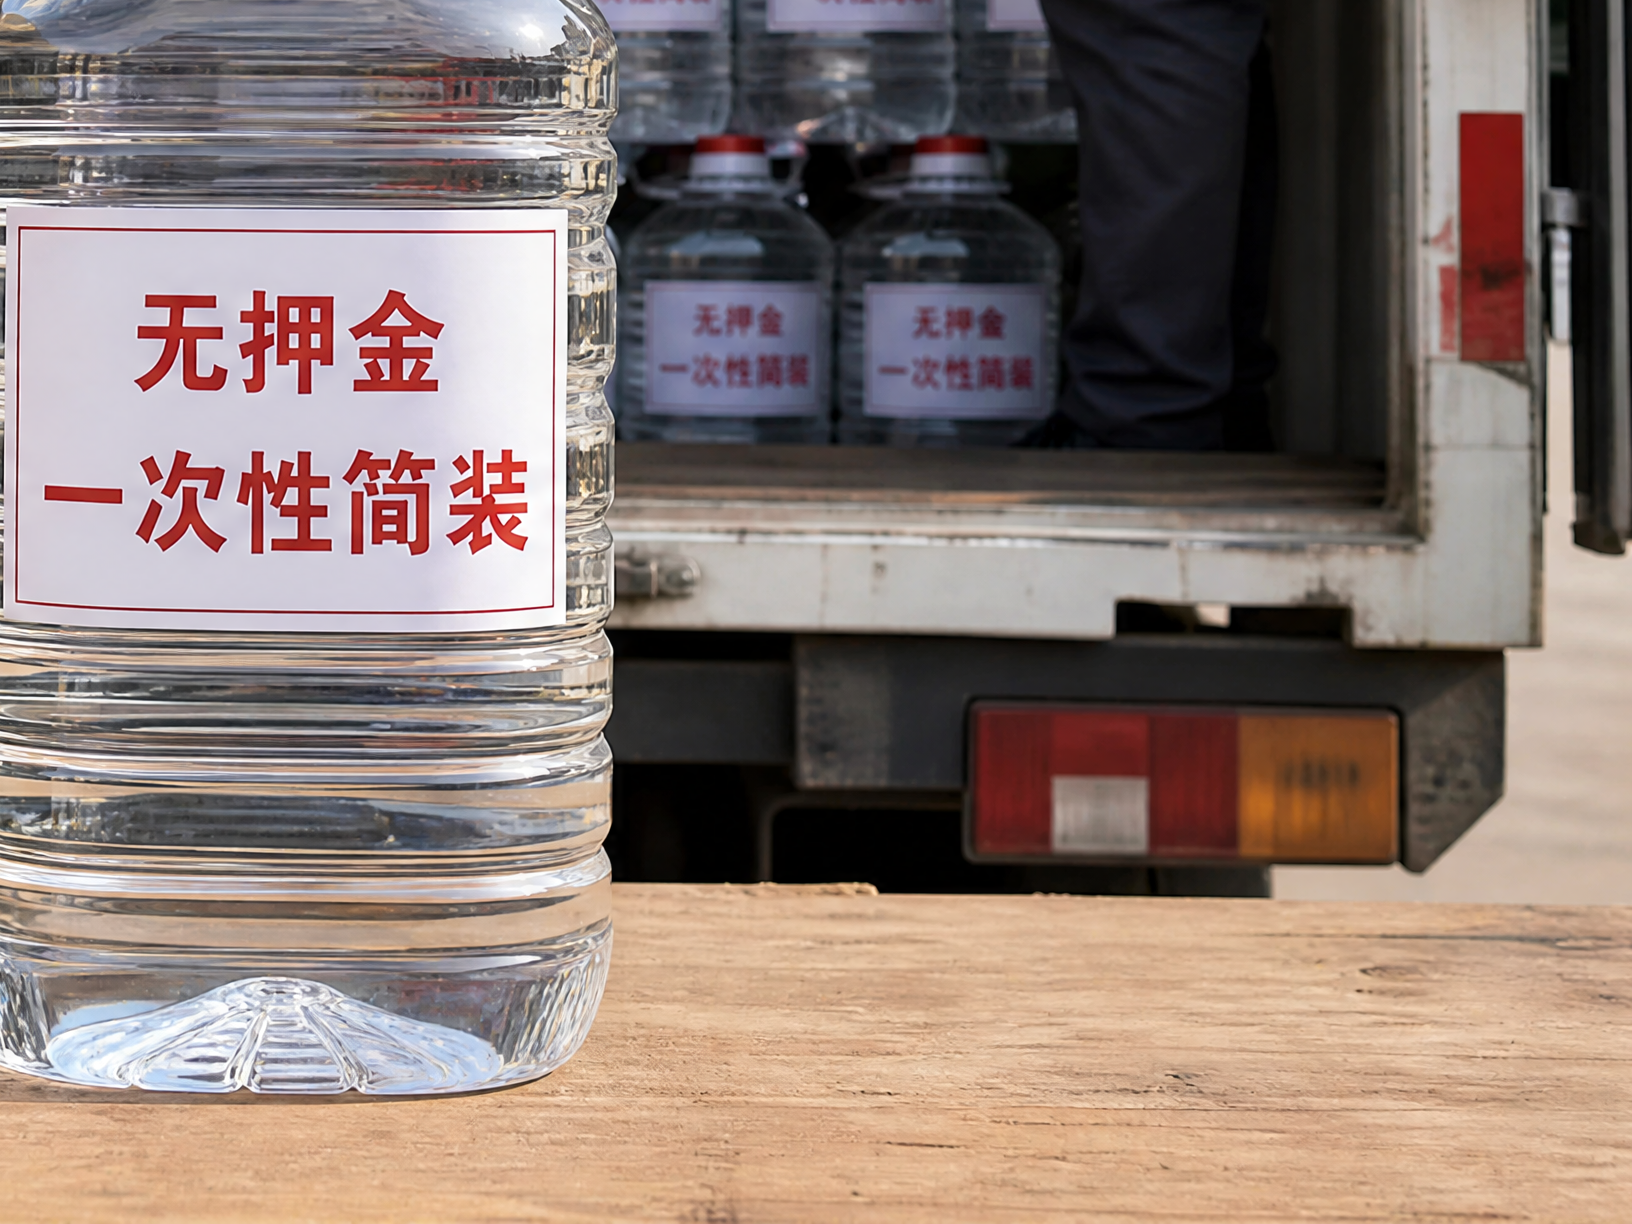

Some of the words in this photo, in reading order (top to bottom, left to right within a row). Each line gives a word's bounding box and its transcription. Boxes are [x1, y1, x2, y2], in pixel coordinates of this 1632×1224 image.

[697, 306, 781, 336] 无押金
[916, 308, 1003, 338] 无押金
[135, 290, 444, 394] 无押金
[662, 354, 808, 387] 一次性简装
[881, 357, 1033, 389] 一次性简装
[45, 449, 528, 555] 一次性简装
